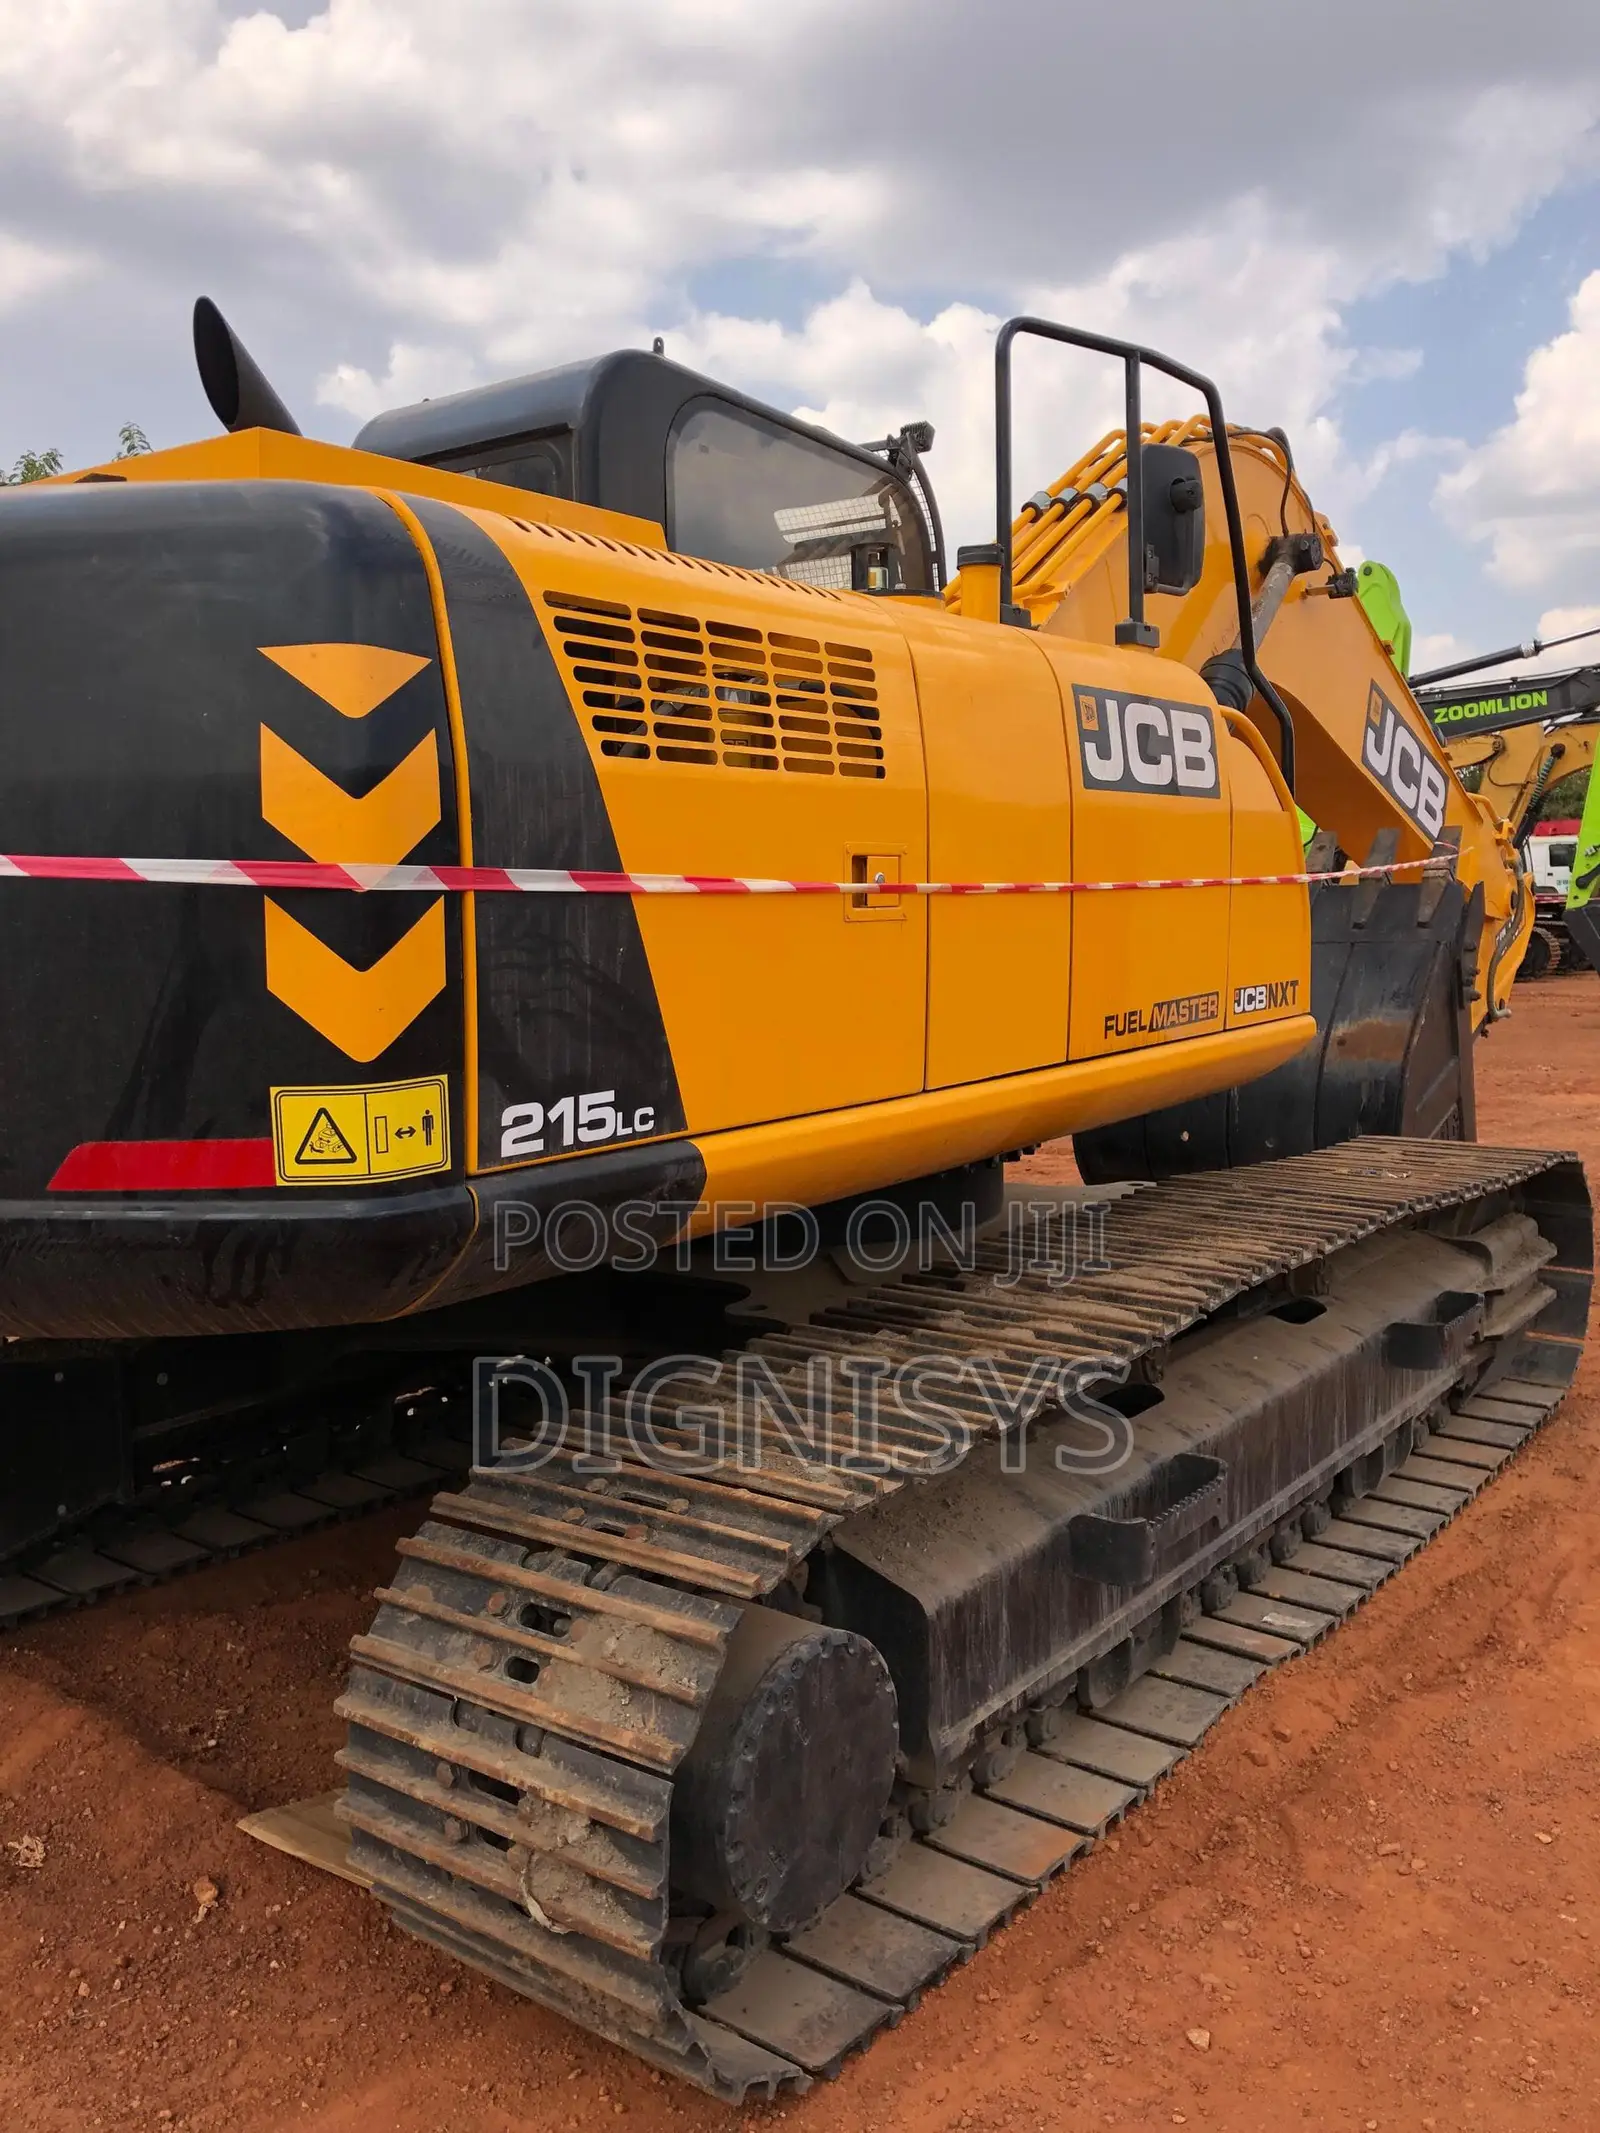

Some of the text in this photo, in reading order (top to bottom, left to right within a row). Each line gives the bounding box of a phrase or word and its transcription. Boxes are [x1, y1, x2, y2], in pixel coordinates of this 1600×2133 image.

[1083, 698, 1216, 789] JCB
[1434, 690, 1548, 724] ZOOMLION
[1366, 707, 1446, 839] JCB
